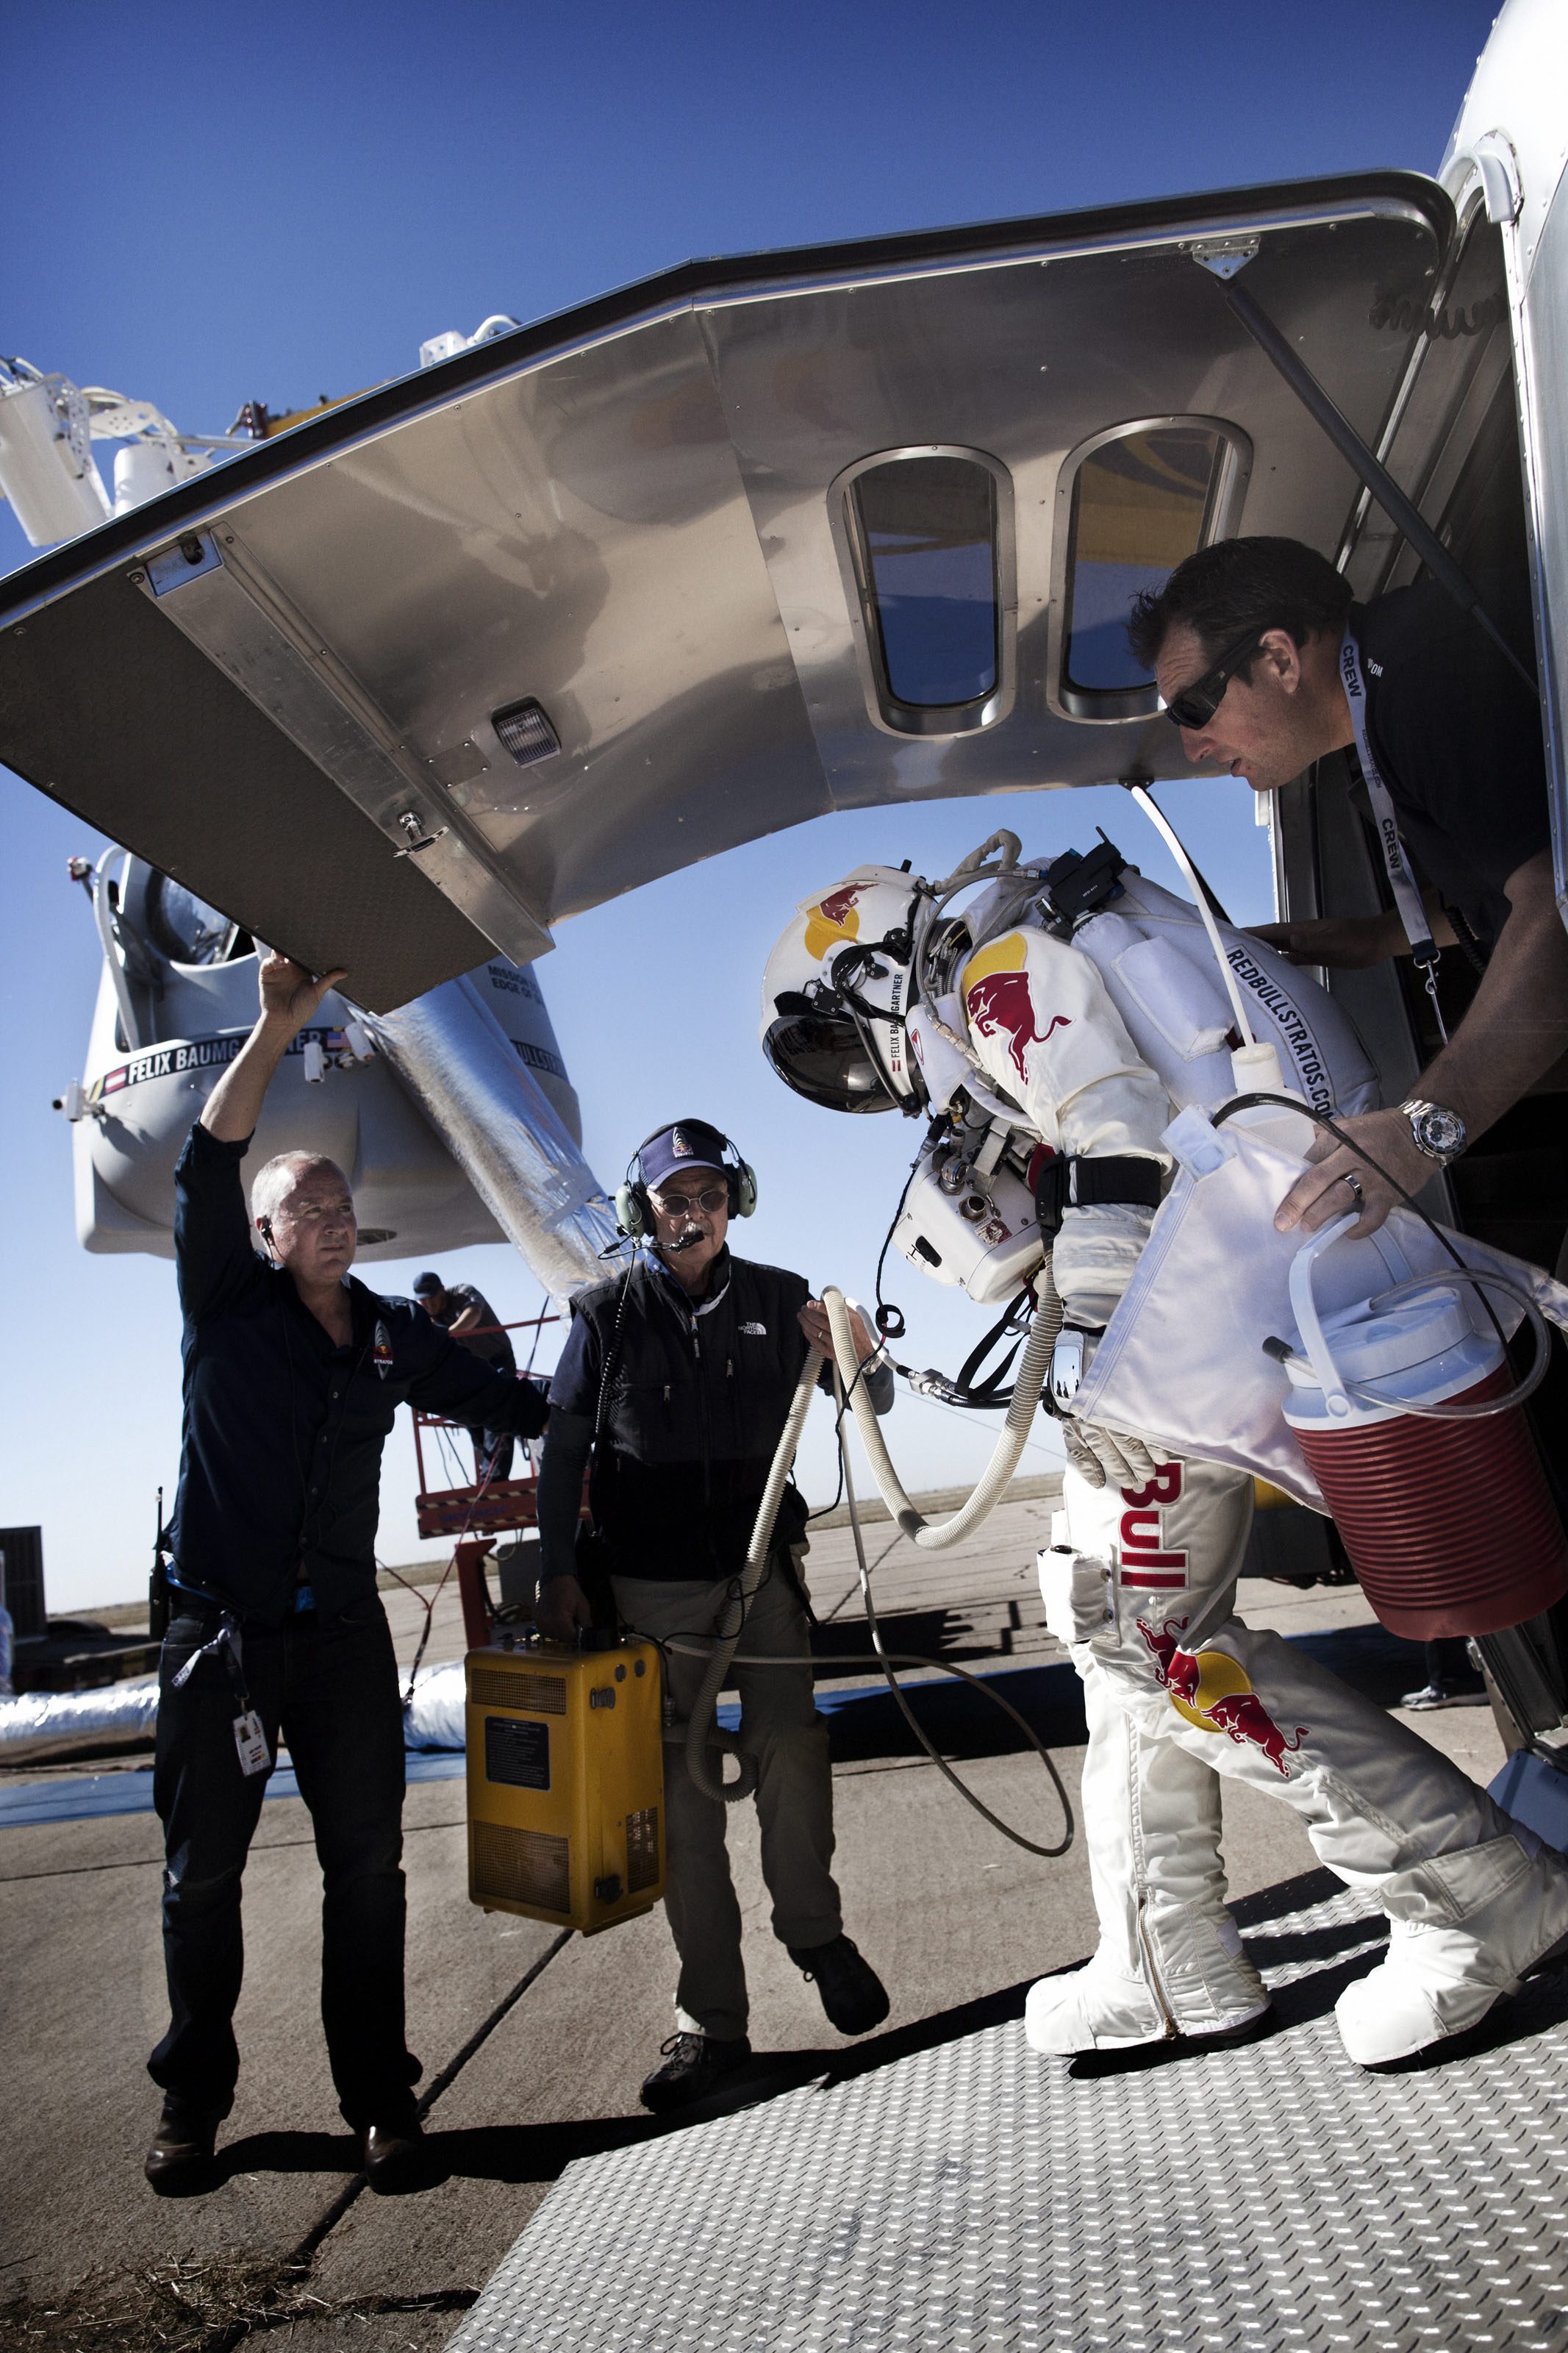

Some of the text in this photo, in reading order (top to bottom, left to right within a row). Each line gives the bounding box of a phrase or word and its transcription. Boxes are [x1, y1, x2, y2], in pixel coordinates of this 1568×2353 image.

[1342, 644, 1362, 697] CREW
[1381, 817, 1400, 870] CREW
[492, 977, 519, 995] EDGE
[889, 973, 903, 1058] FELIX BAGARTNER
[128, 1051, 171, 1085] FELIX
[1120, 1462, 1187, 1588] Bull
